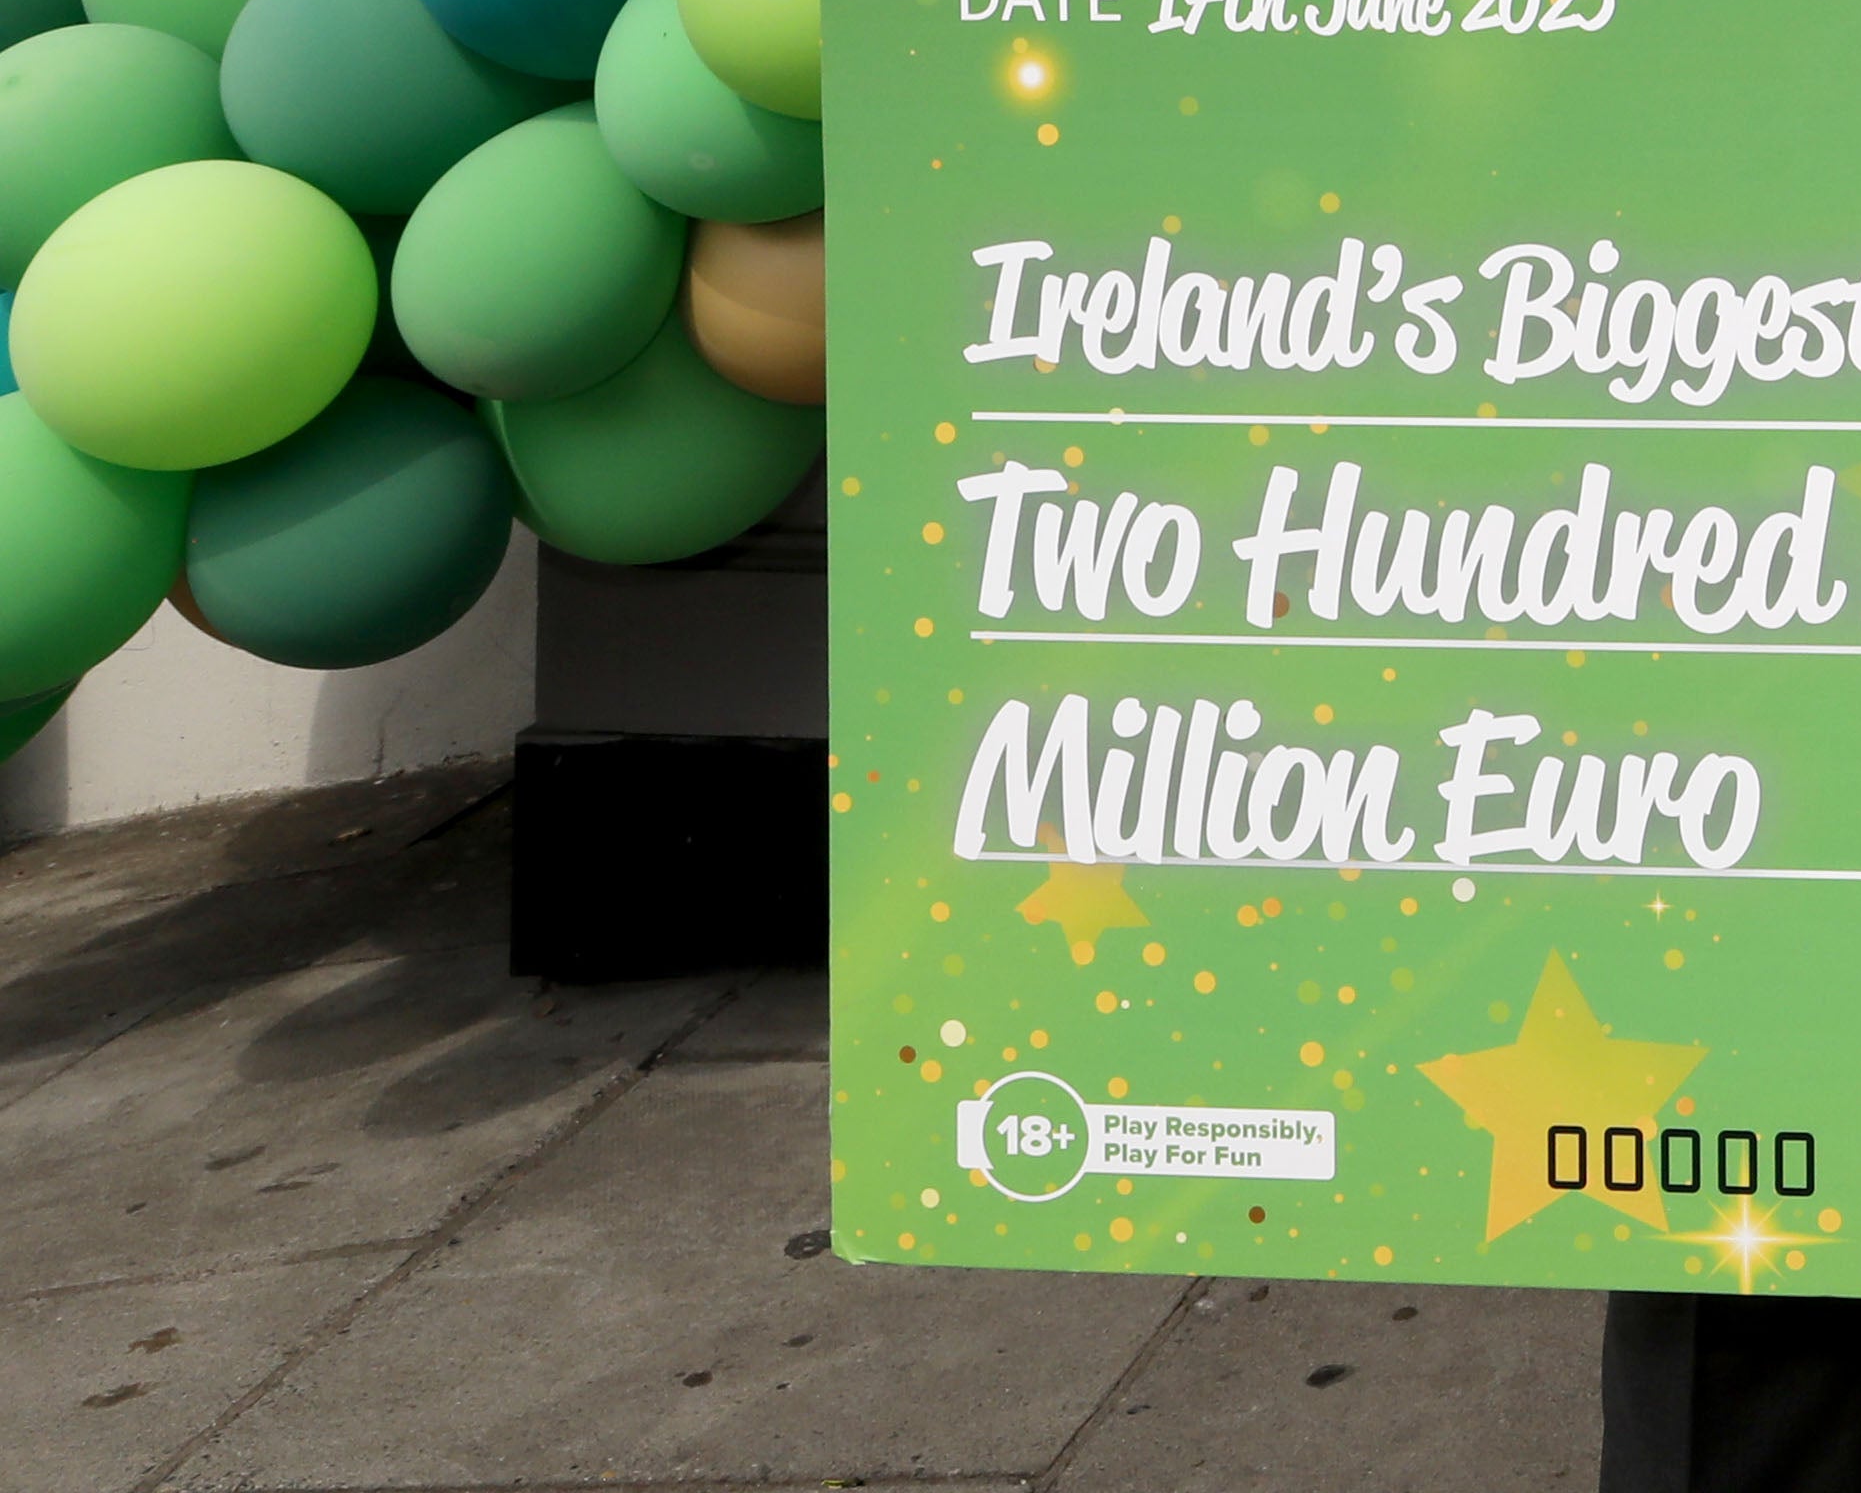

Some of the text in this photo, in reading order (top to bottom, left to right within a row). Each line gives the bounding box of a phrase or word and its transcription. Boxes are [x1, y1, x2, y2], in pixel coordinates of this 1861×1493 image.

[956, 460, 1202, 621] Two
[1231, 460, 1848, 634] Hundred
[953, 693, 1763, 870] Million Euro
[995, 1113, 1077, 1158] 18+
[1103, 1114, 1158, 1139] Play
[1103, 1143, 1262, 1169] Play For Fun
[1547, 1124, 1816, 1198] 00000
